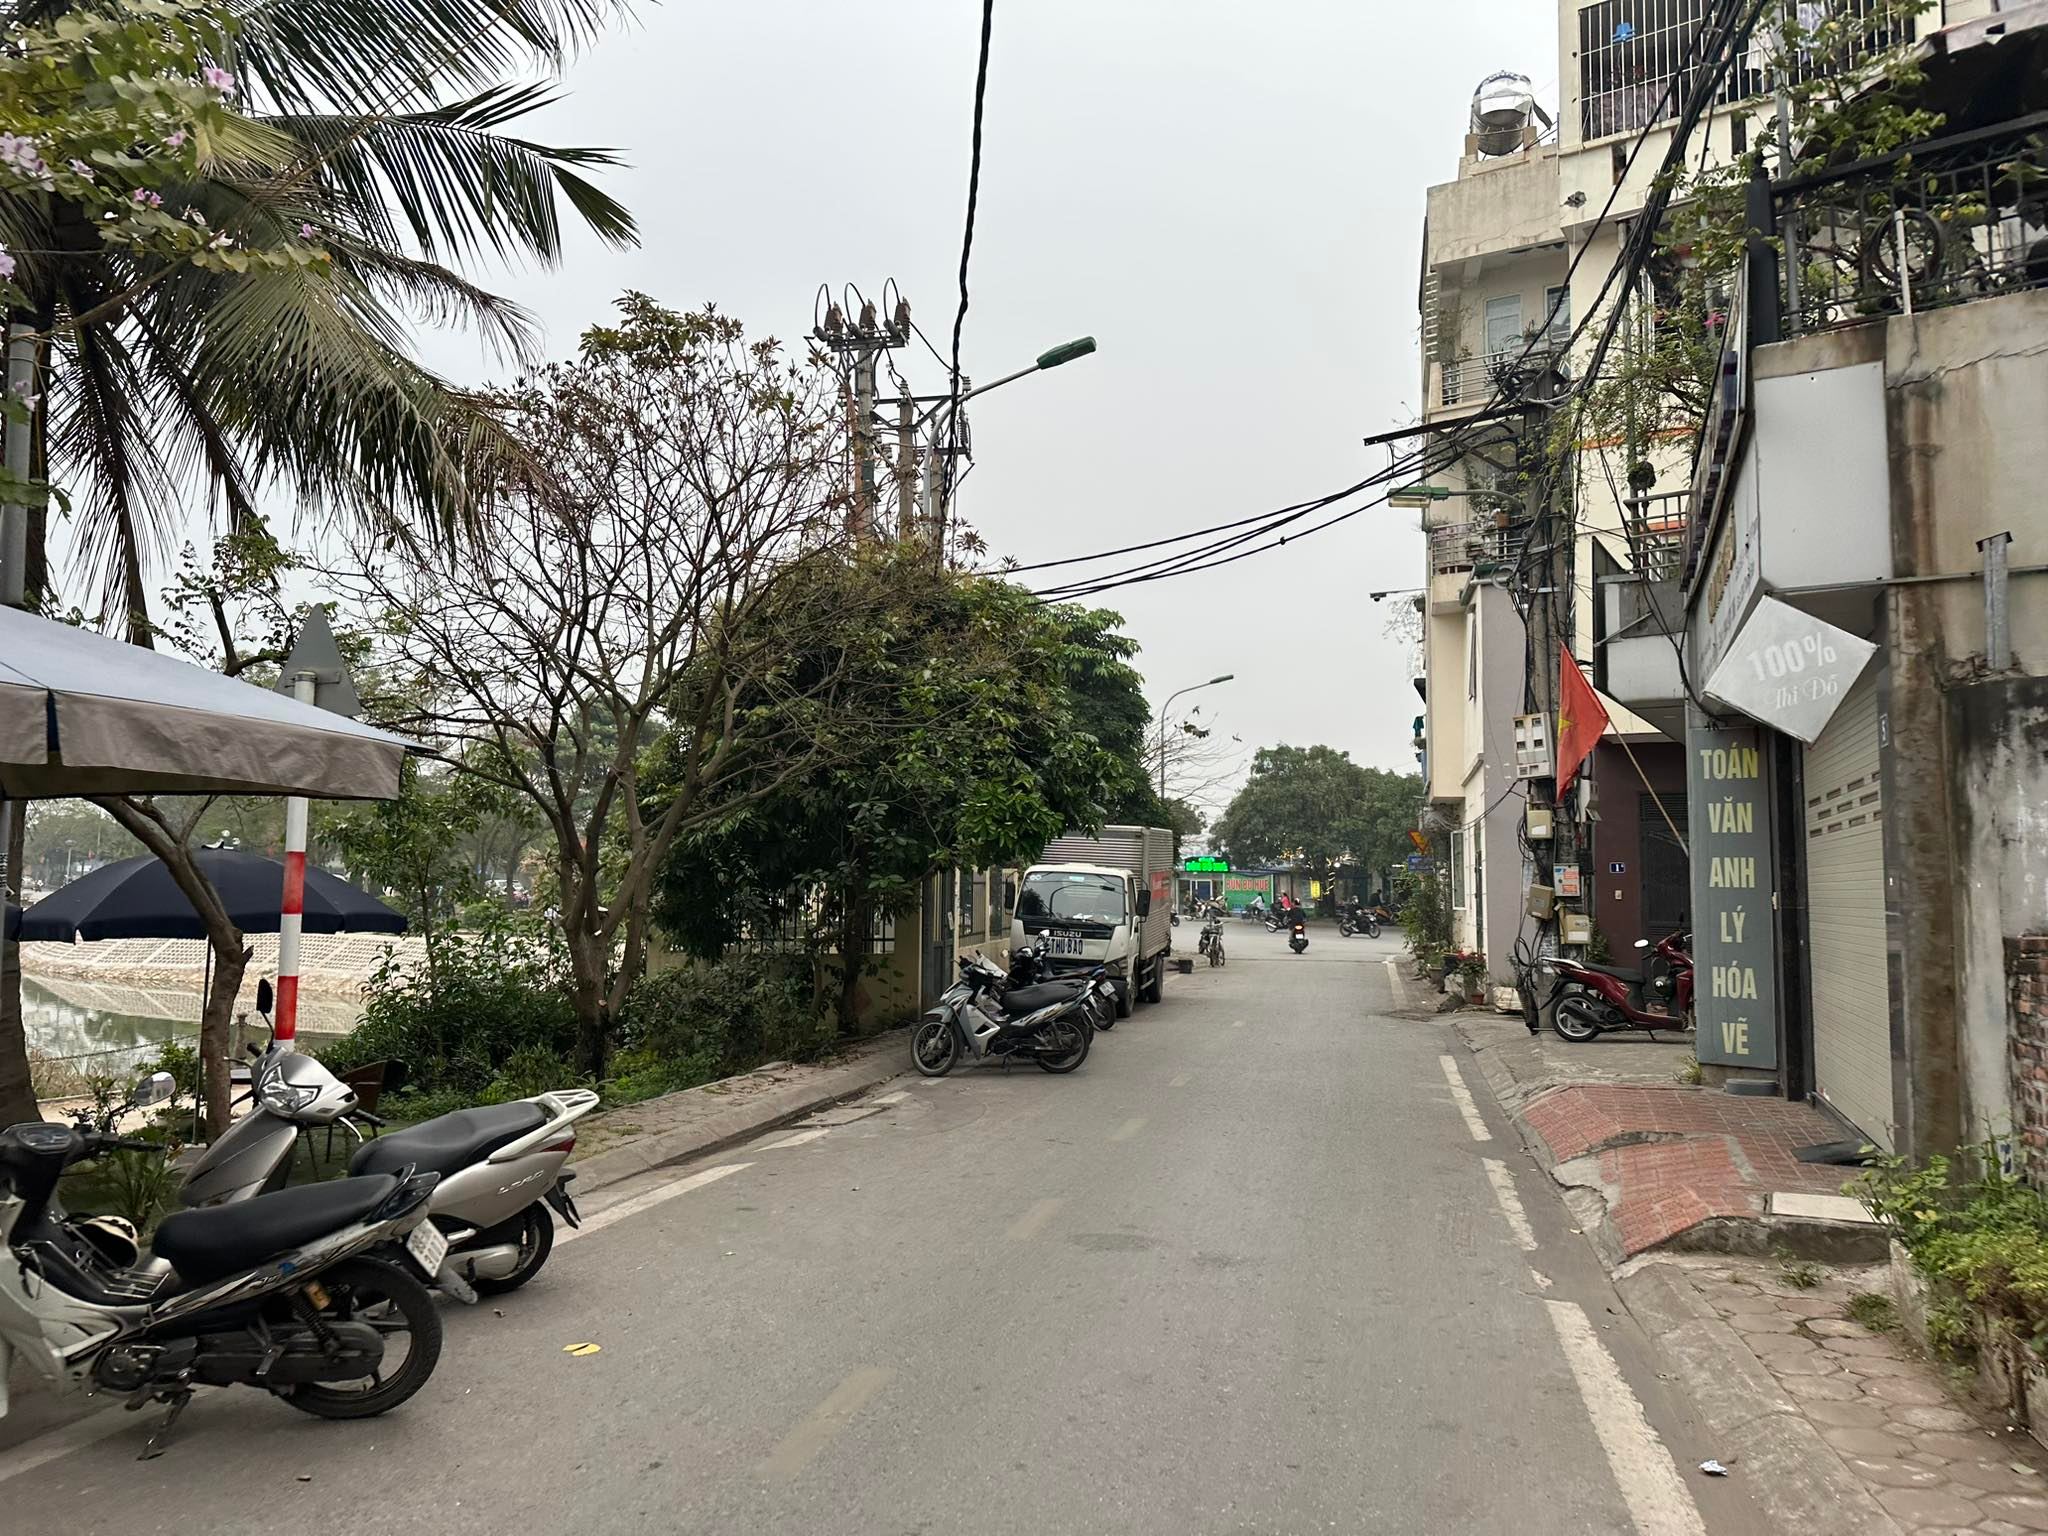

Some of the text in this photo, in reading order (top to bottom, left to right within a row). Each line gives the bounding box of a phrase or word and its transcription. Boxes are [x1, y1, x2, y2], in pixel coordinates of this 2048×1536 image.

[1748, 632, 1837, 681] 100%
[1700, 742, 1758, 779] TOÁN
[1708, 796, 1753, 833] VĂN
[1709, 857, 1755, 888] ANH
[1054, 930, 1082, 938] ISUZU
[1720, 905, 1745, 943] LÝ
[1712, 960, 1757, 1000] HÓA
[1721, 1016, 1749, 1055] VẼ
